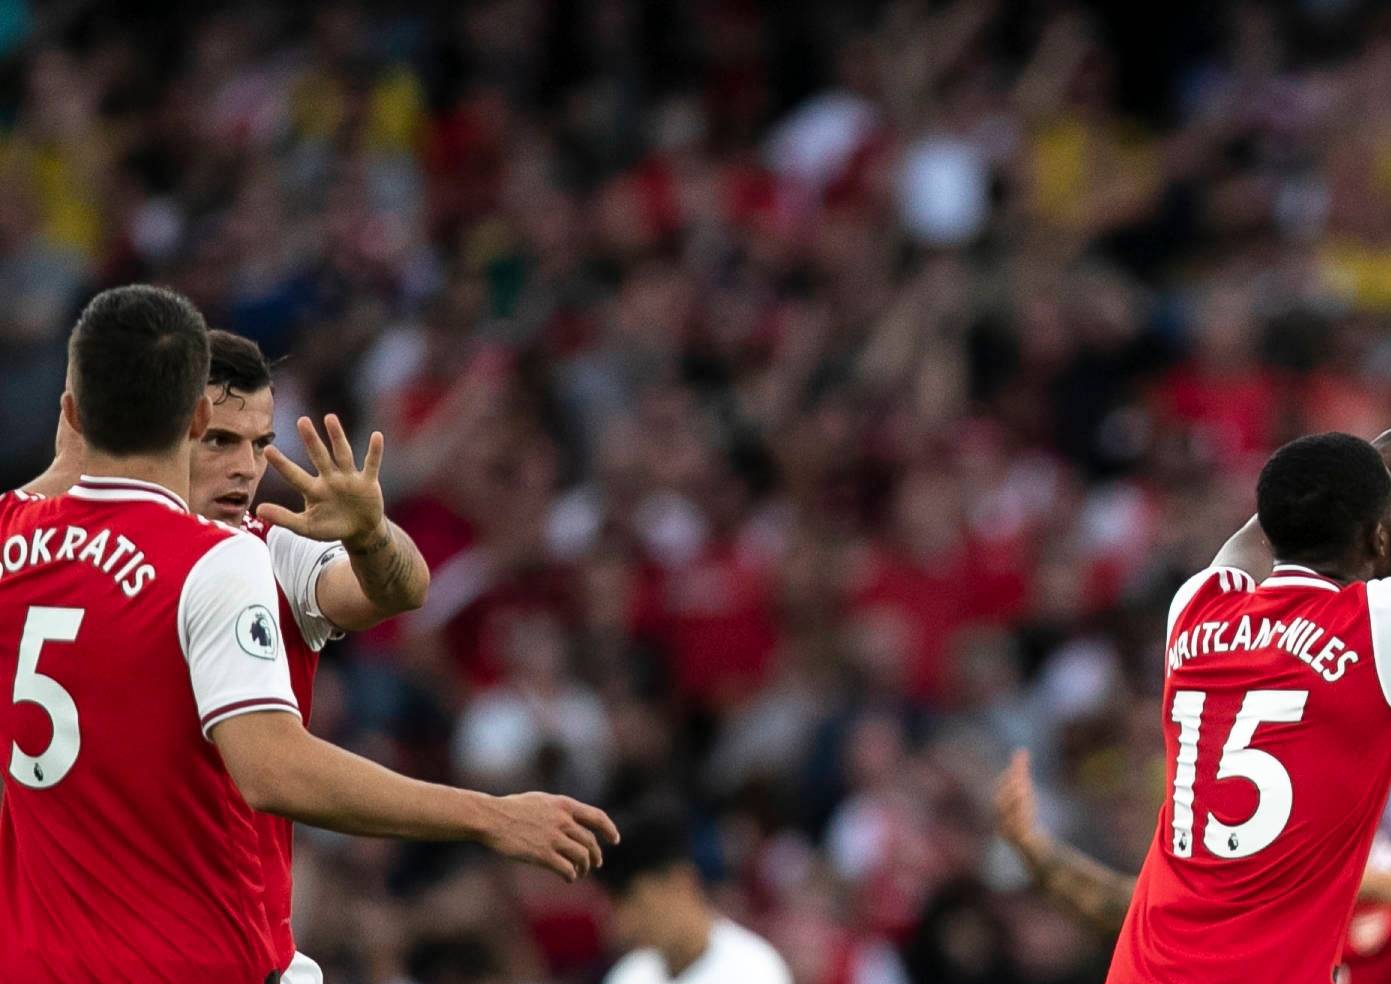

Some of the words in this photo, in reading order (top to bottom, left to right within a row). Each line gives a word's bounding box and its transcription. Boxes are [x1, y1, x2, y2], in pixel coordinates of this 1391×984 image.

[0, 525, 157, 599] OKRATIS
[10, 605, 86, 790] 5
[1171, 690, 1309, 860] 15
